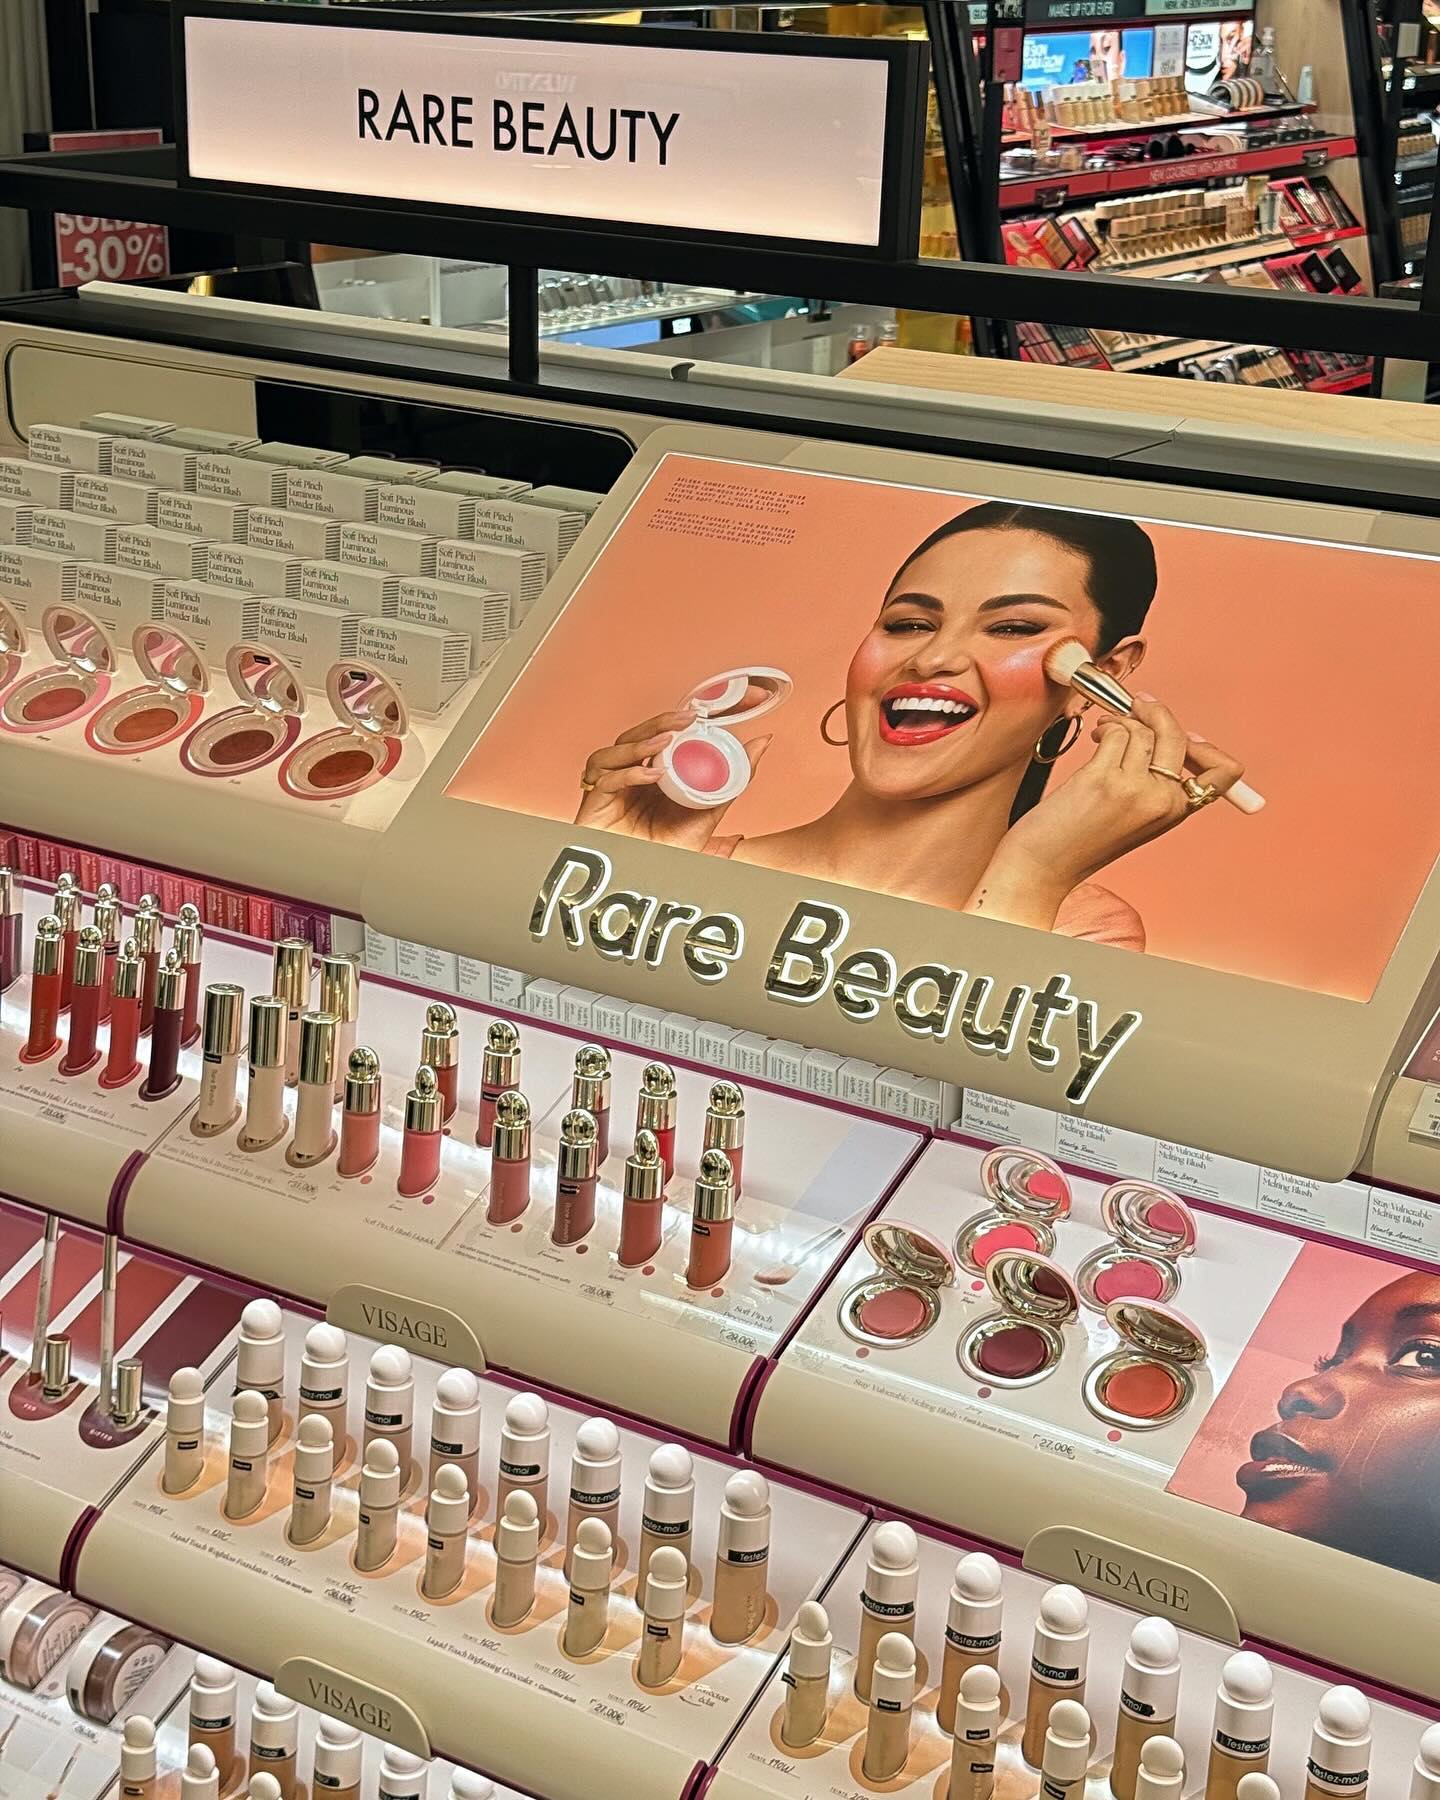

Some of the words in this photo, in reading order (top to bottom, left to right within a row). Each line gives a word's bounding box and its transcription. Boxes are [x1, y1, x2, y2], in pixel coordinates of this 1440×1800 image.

[358, 88, 473, 148] RARE
[493, 99, 680, 165] BEAUTY
[289, 479, 302, 487] Soft
[303, 481, 323, 491] Pinch
[289, 488, 322, 500] Luminous
[380, 493, 393, 501] Soft
[396, 495, 415, 506] Pinch
[289, 498, 313, 509] Powder
[315, 502, 333, 512] Blush
[380, 503, 414, 515] Luminous
[380, 513, 404, 524] Powder
[407, 517, 426, 528] Blush
[477, 509, 490, 518] Soft
[493, 512, 513, 522] Pinch
[476, 520, 512, 532] Luminous
[342, 531, 355, 539] Soft
[358, 533, 377, 544] Pinch
[476, 530, 502, 541] Powder
[505, 534, 524, 545] Blush
[342, 541, 376, 553] Luminous
[342, 551, 366, 563] Powder
[369, 556, 388, 567] Blush
[303, 568, 316, 577] Soft
[319, 571, 338, 582] Pinch
[303, 578, 337, 591] Luminous
[165, 590, 178, 598] Soft
[180, 592, 200, 602] Pinch
[302, 589, 327, 600] Powder
[330, 594, 349, 605] Blush
[165, 599, 199, 611] Luminous
[261, 606, 275, 614] Soft
[277, 608, 297, 619] Pinch
[165, 609, 190, 621] Powder
[192, 615, 210, 625] Blush
[261, 616, 295, 629] Luminous
[260, 626, 285, 638] Powder
[288, 632, 307, 643] Blush
[360, 627, 374, 636] Soft
[377, 630, 397, 640] Pinch
[359, 637, 395, 650] Luminous
[359, 648, 385, 660] Powder
[388, 653, 407, 664] Blush
[528, 846, 745, 981] Rare
[764, 900, 1143, 1103] Beauty
[966, 1090, 981, 1099] Stay
[983, 1093, 1016, 1110] Vulnerable
[966, 1098, 990, 1112] Melting
[991, 1103, 1009, 1117] Blush
[1060, 1114, 1075, 1124] Stay
[1077, 1117, 1112, 1135] Vulnerable
[1060, 1122, 1084, 1137] Melting
[1086, 1128, 1105, 1142] Blush
[1160, 1141, 1175, 1151] Stay
[1176, 1145, 1213, 1162] Vulnerable
[1159, 1150, 1184, 1165] Melting
[1186, 1156, 1206, 1170] Blush
[1263, 1177, 1289, 1193] Melting
[1291, 1184, 1312, 1198] Blush
[1264, 1169, 1279, 1180] Stay
[1280, 1172, 1320, 1190] Vulnerable
[1373, 1207, 1400, 1223] Melting
[1402, 1214, 1424, 1228] Blush
[1374, 1198, 1389, 1208] Stay
[1391, 1202, 1432, 1221] Vulnerable
[360, 1303, 448, 1348] VISAGE
[1072, 1547, 1190, 1612] VISAGE
[307, 1677, 392, 1732] VISAGE
[1312, 1765, 1361, 1784] Testez-moi
